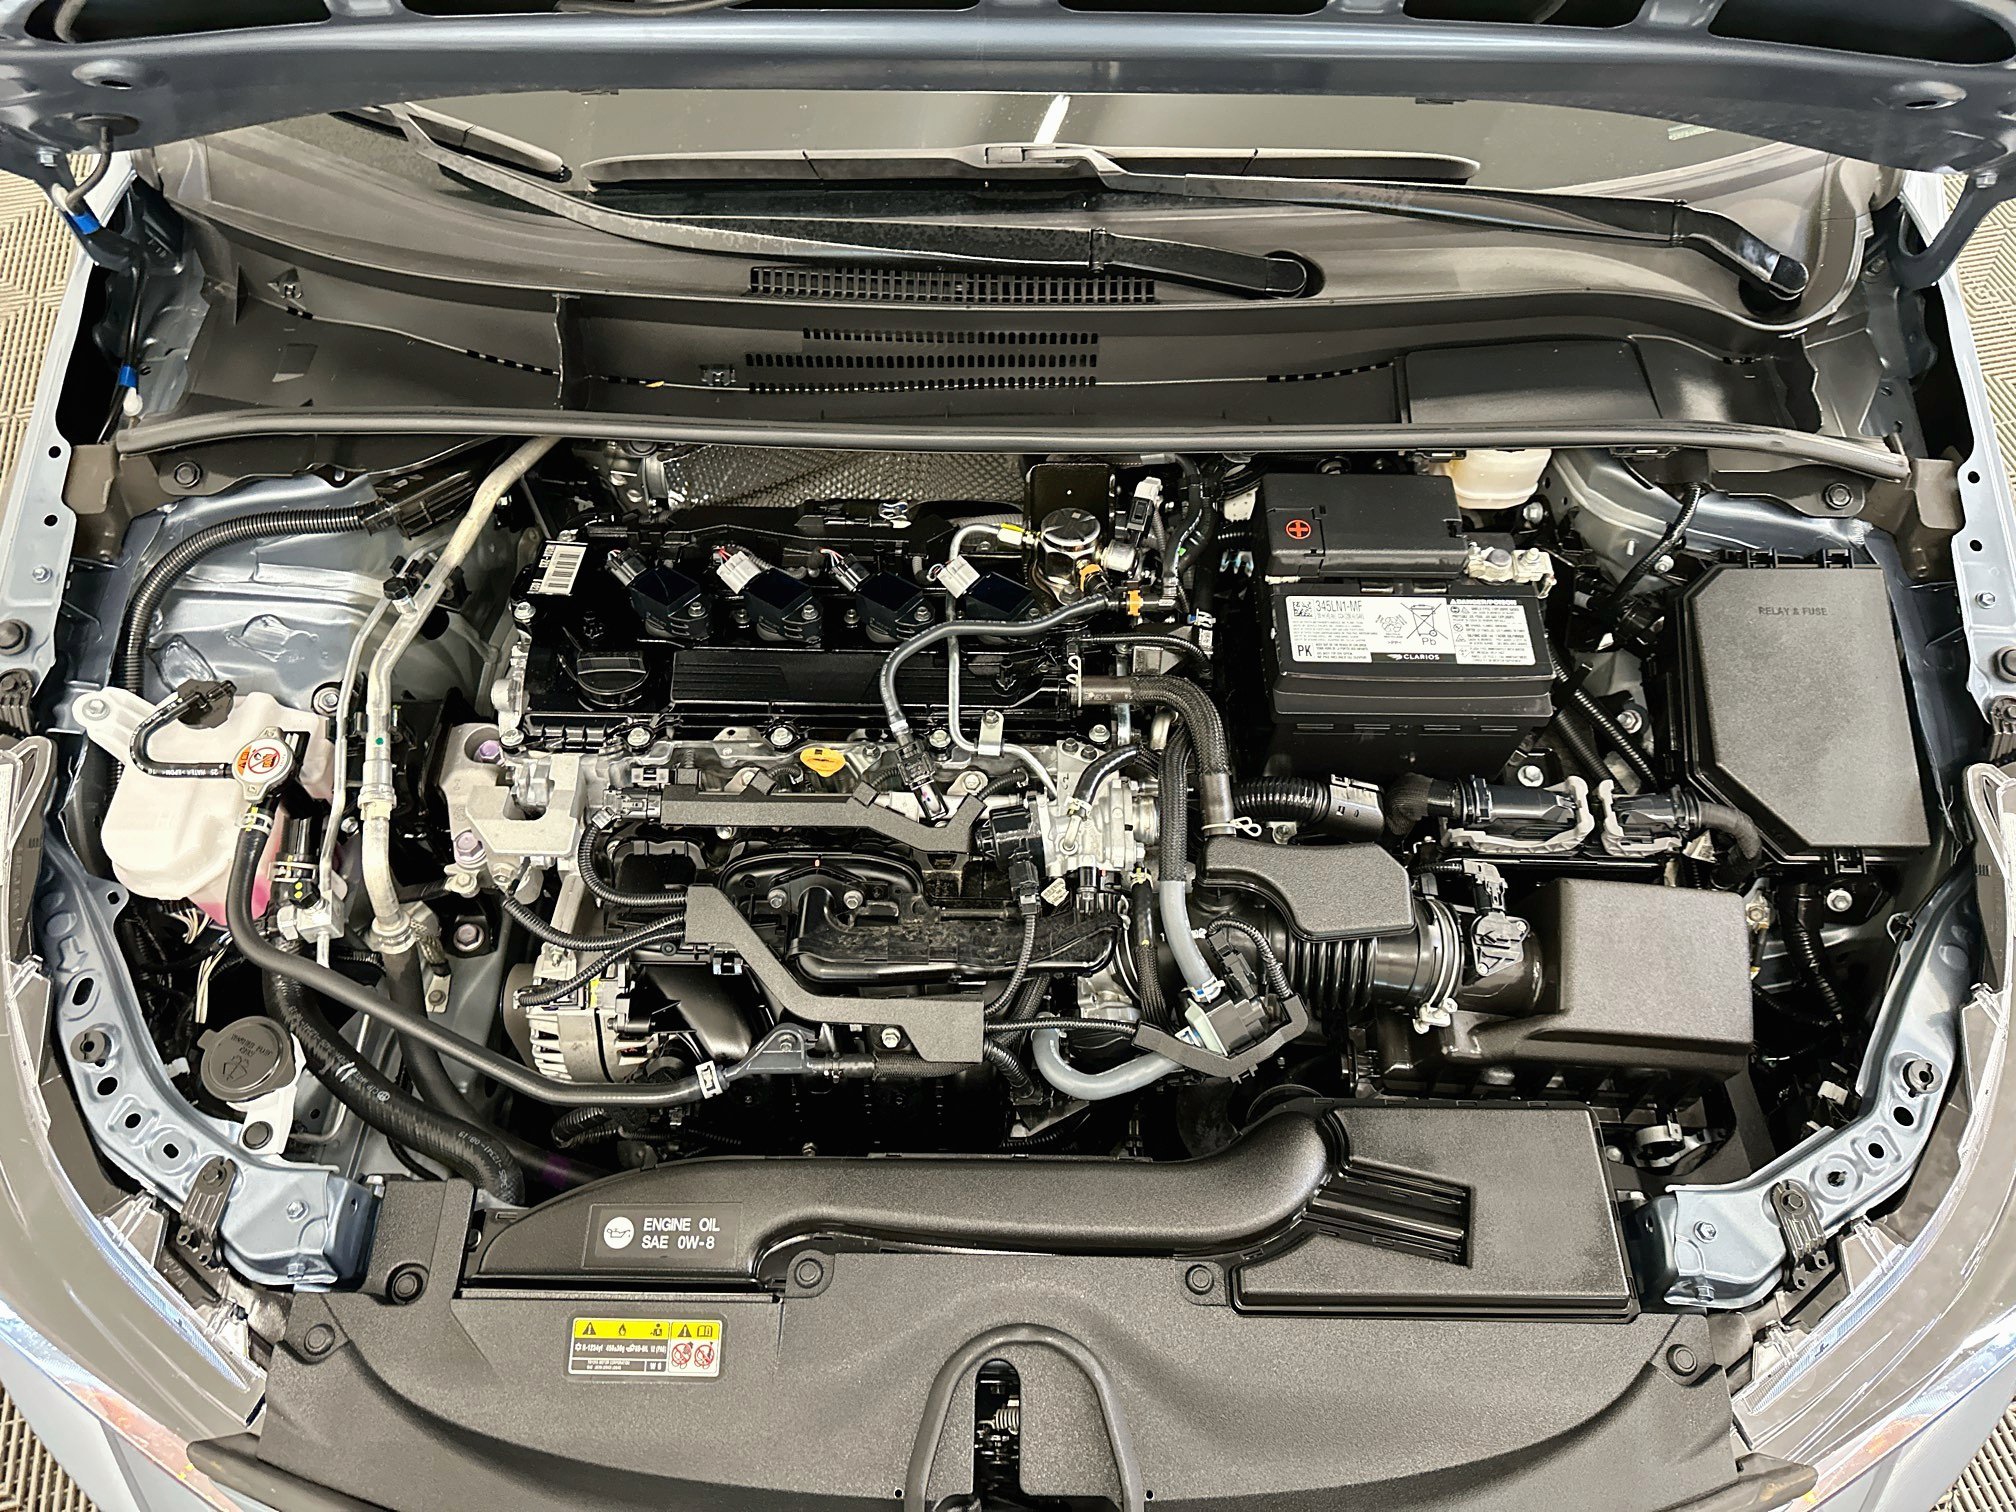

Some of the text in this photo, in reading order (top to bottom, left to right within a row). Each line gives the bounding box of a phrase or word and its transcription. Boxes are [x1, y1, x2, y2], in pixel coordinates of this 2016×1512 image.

[1315, 600, 1362, 612] 345LN1-MF
[1758, 606, 1828, 616] RELAY & FUSE
[1421, 637, 1437, 645] Pb
[1297, 644, 1312, 656] PK
[1403, 653, 1440, 661] CLARIOS
[643, 1217, 720, 1232] ENGINE OIL
[641, 1235, 715, 1250] SAE 0W-8
